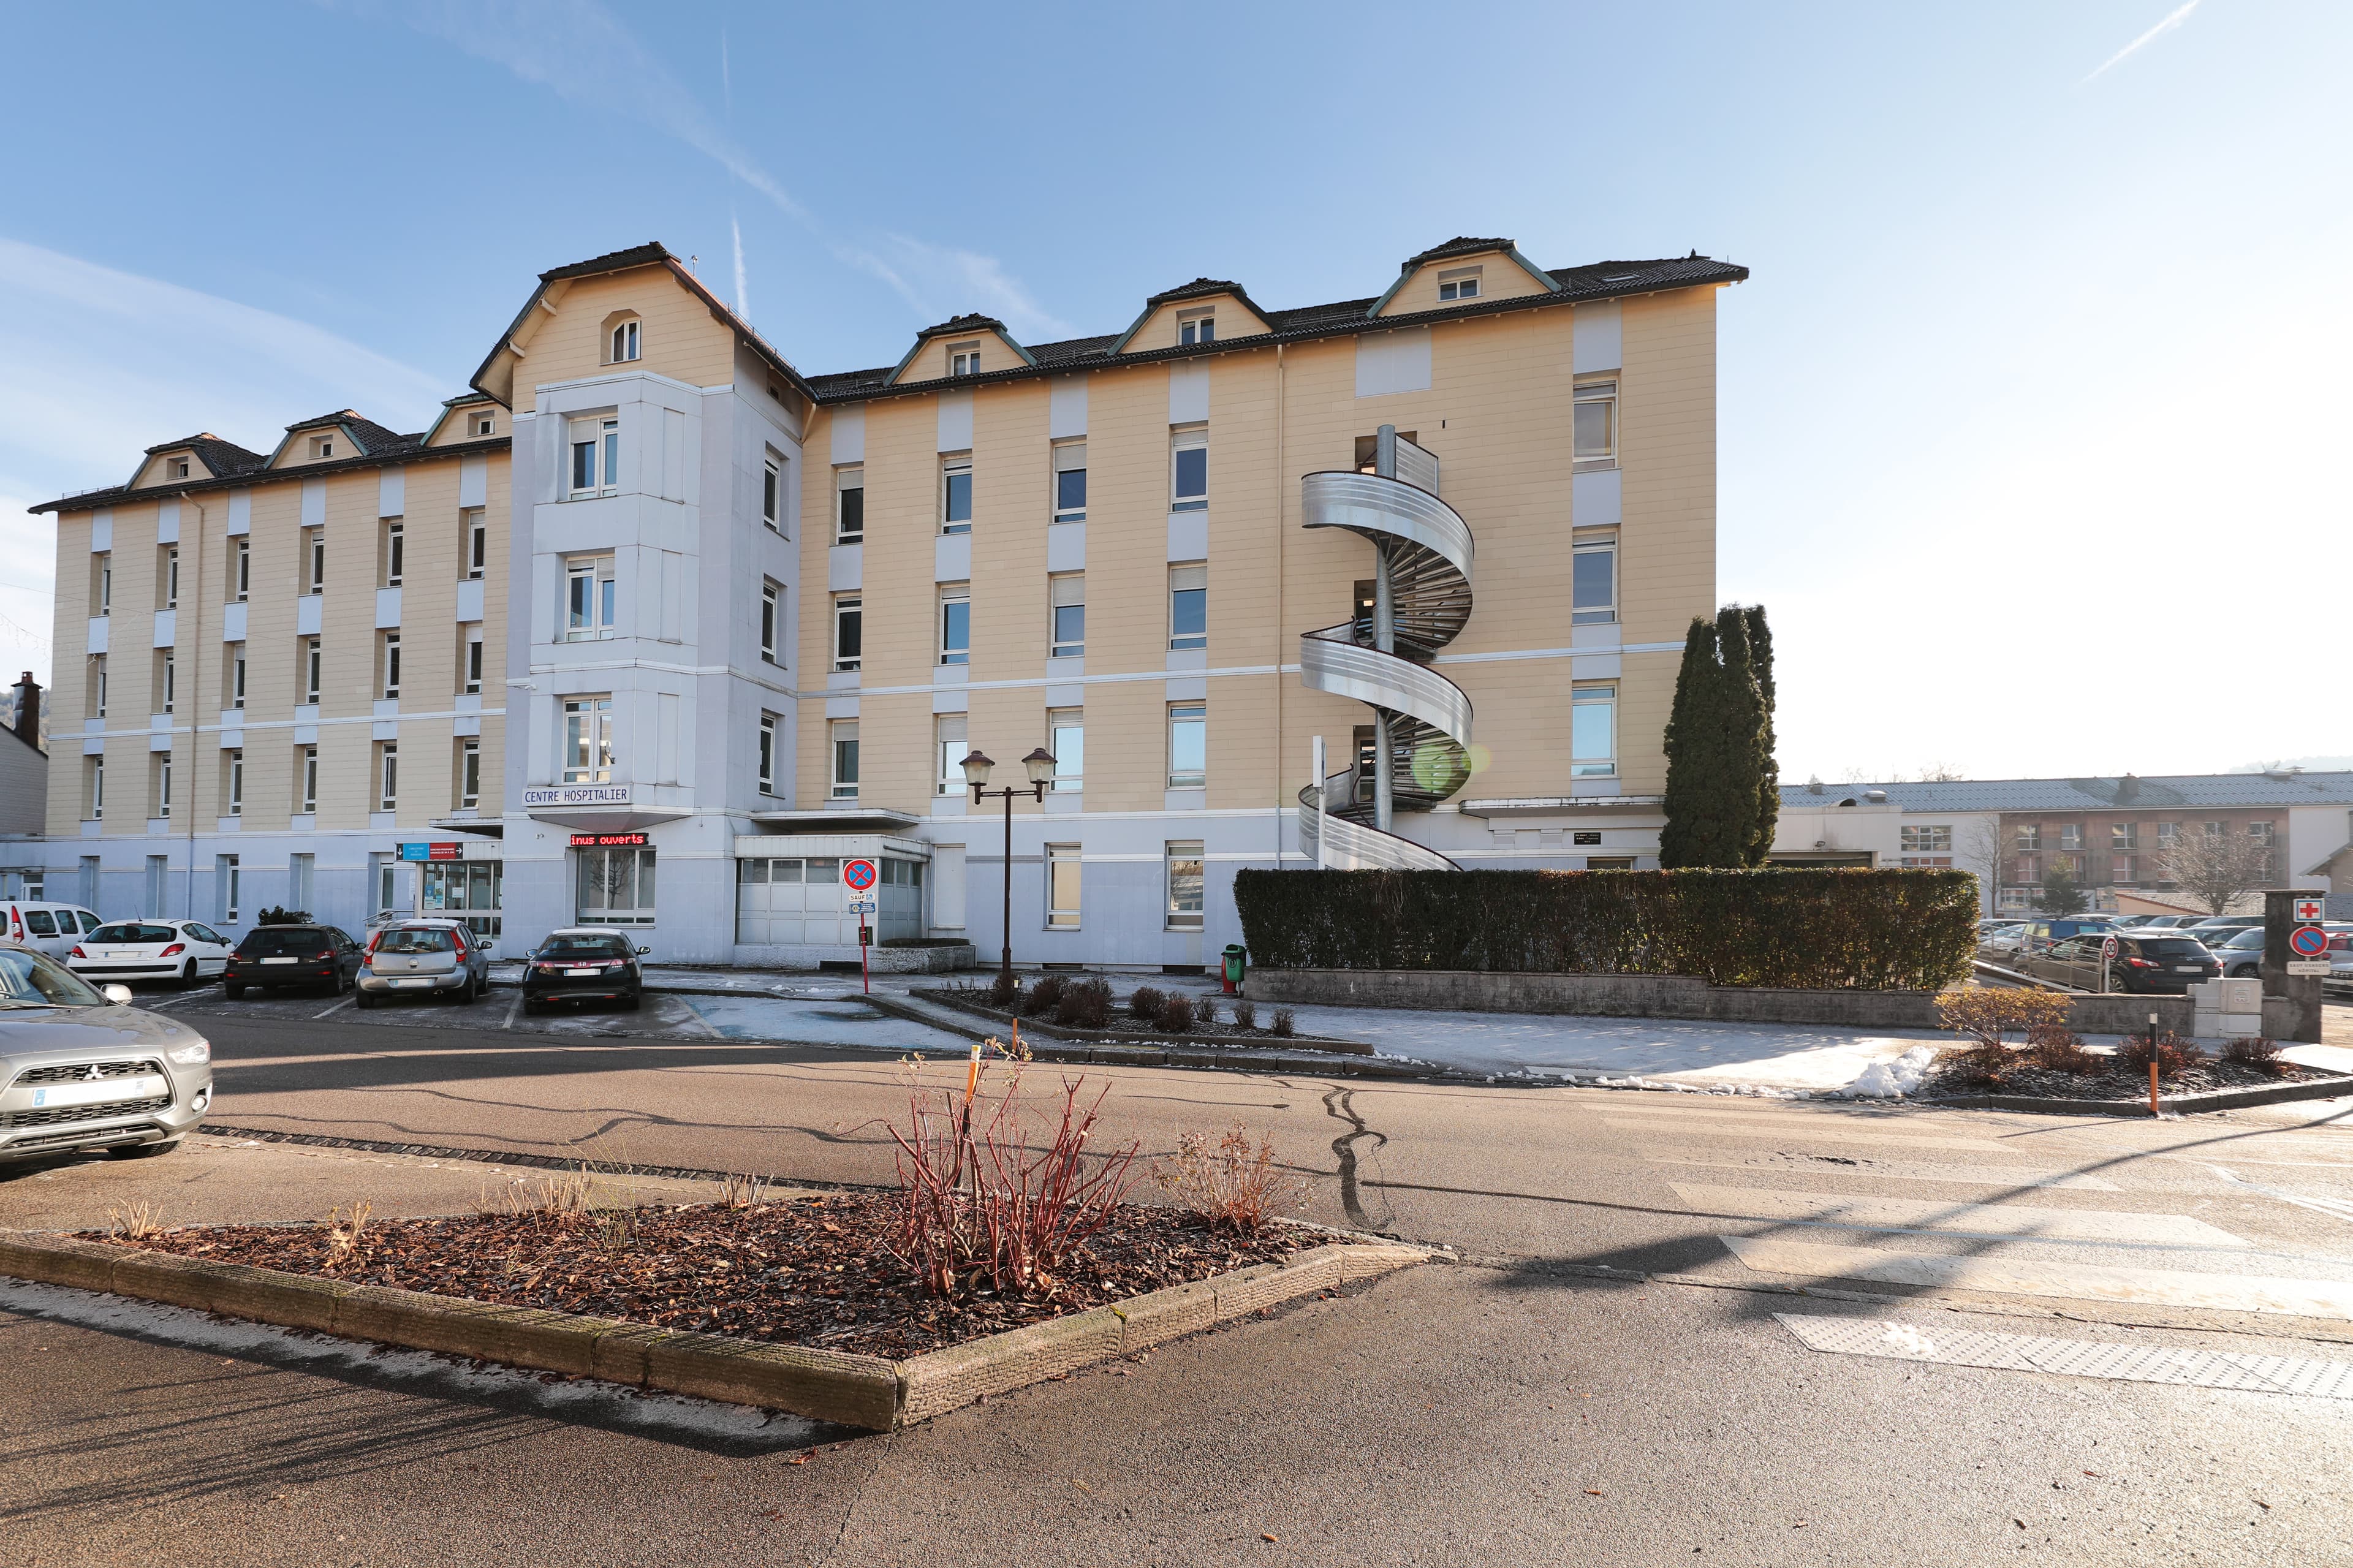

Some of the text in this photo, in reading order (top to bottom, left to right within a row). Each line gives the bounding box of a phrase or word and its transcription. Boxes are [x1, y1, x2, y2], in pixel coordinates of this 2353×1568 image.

[525, 789, 627, 803] CENTRE HOSPITALIER
[571, 834, 643, 845] inus ouverts
[2107, 944, 2115, 953] 30
